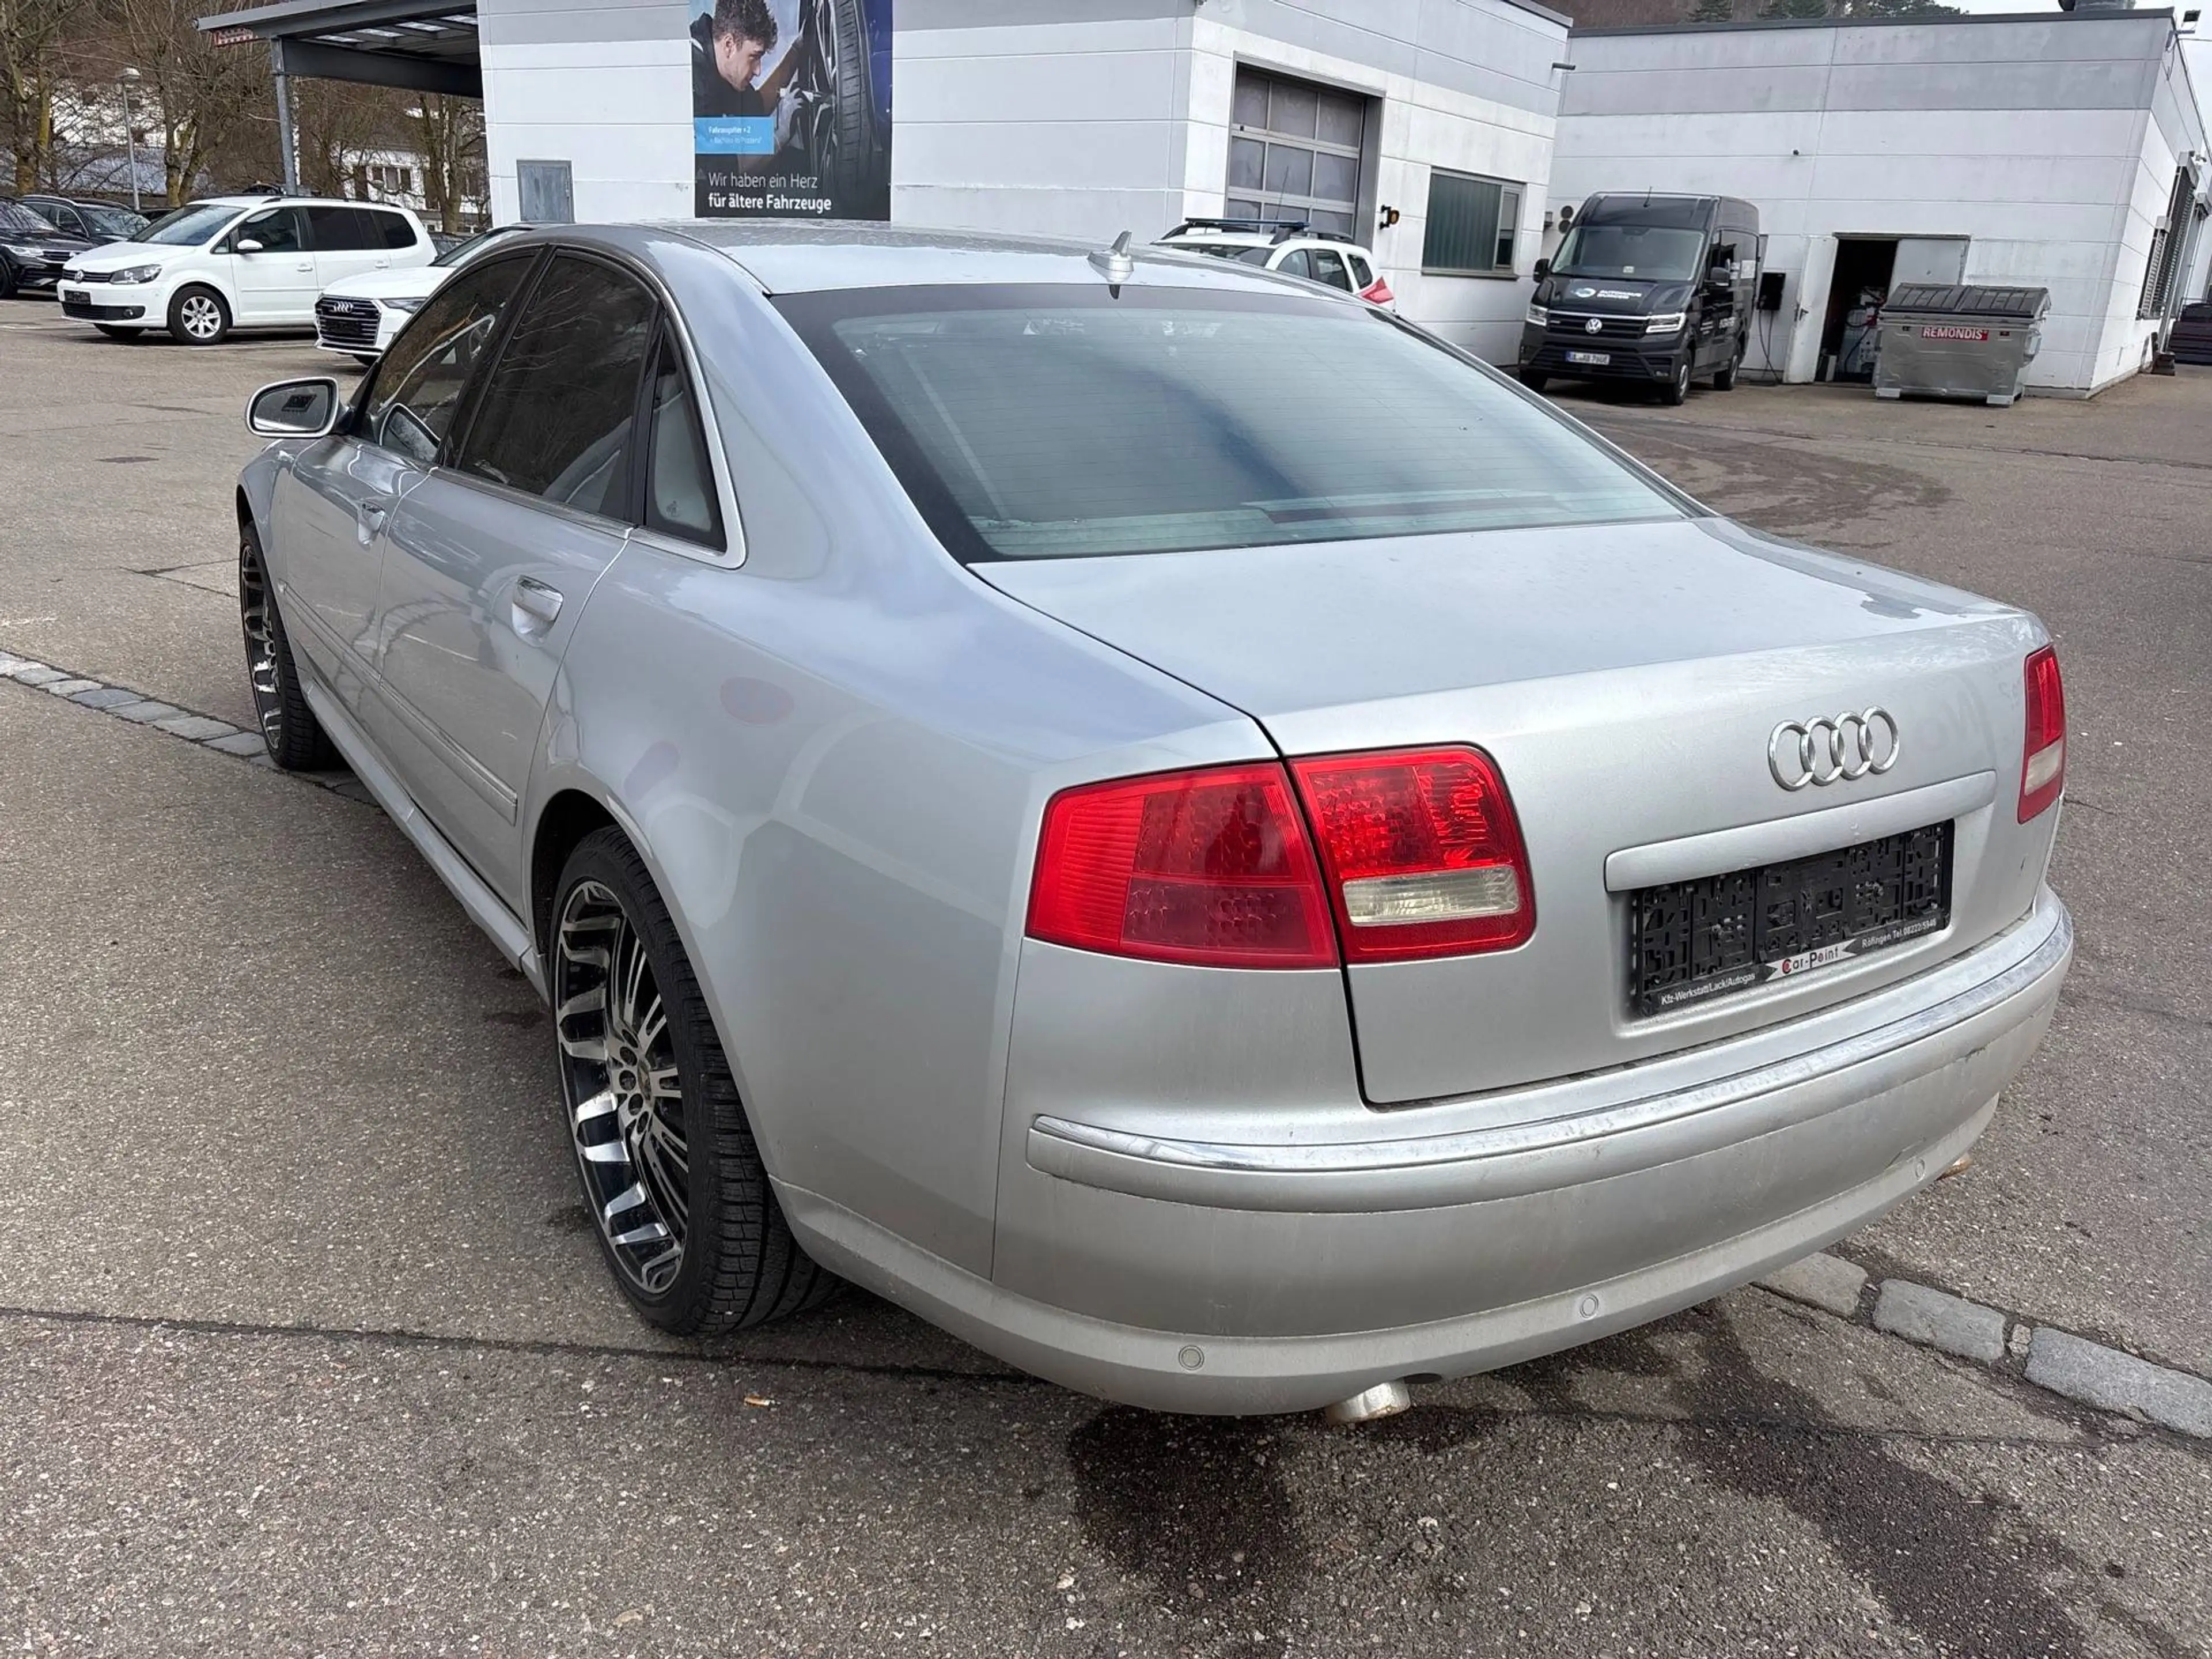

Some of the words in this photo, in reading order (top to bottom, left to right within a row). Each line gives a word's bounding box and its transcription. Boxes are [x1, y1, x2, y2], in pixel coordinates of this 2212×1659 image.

[708, 172, 727, 187] Wir
[730, 172, 766, 188] haben
[769, 173, 786, 188] ein
[790, 173, 818, 189] Herz
[708, 192, 726, 207] für
[729, 192, 763, 209] ältere
[766, 194, 832, 214] Fahrzeuge
[1923, 327, 1983, 340] REMONDIS
[1782, 946, 1839, 974] Car-Point
